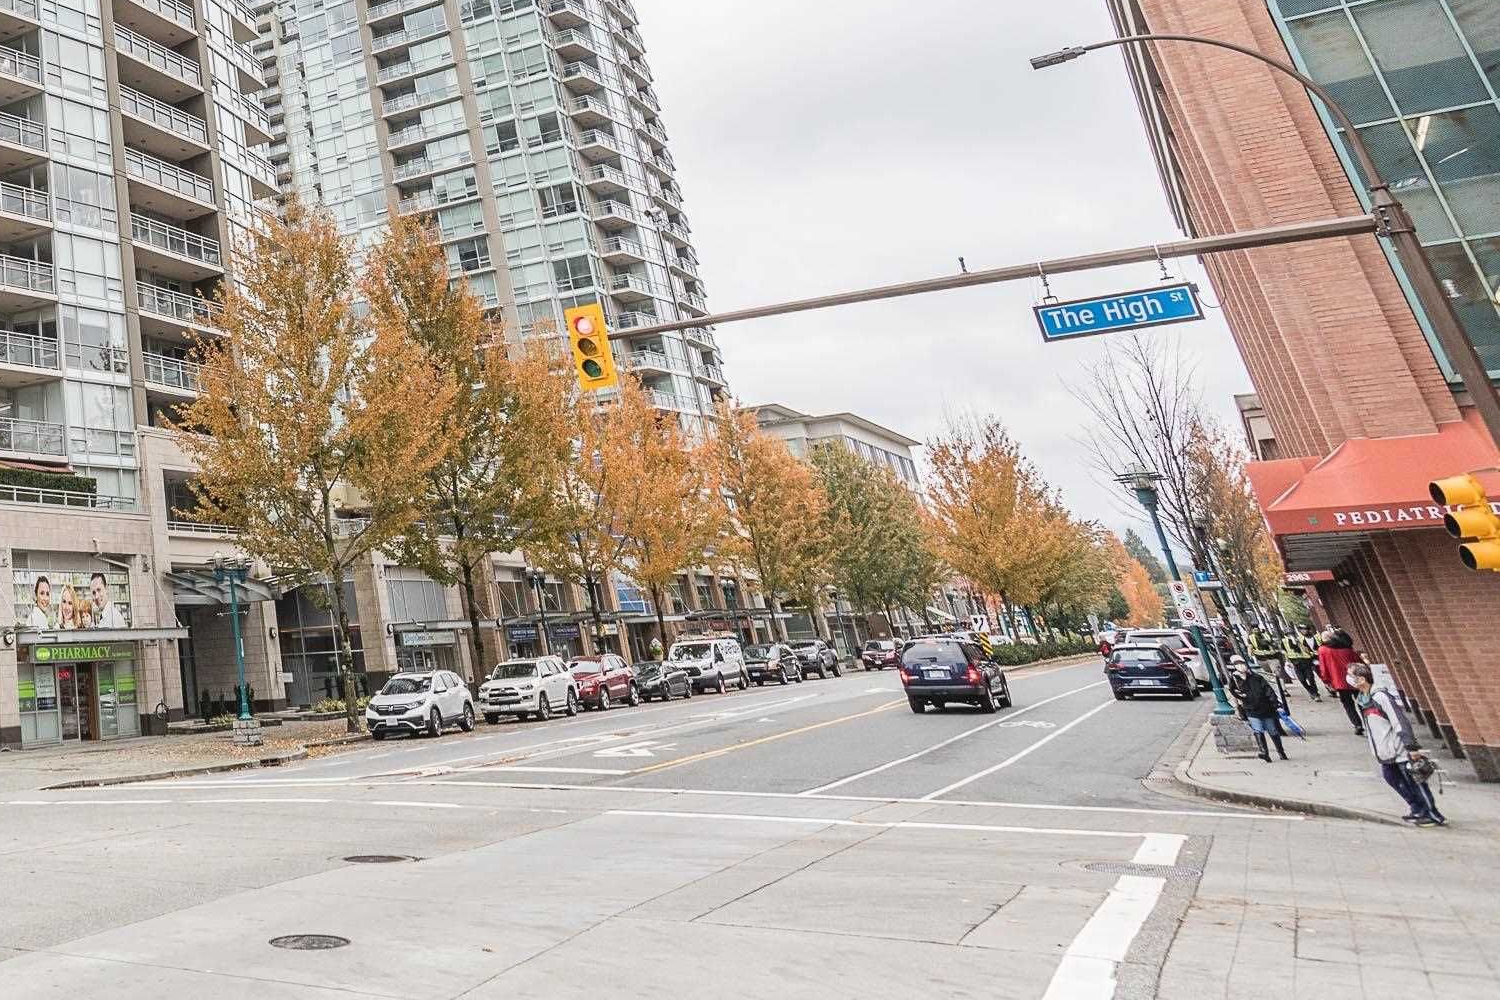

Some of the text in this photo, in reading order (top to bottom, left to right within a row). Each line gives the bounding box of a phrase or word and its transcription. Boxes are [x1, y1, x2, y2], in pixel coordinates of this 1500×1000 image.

[1048, 291, 1184, 329] The High St
[52, 646, 111, 660] PHARMACY
